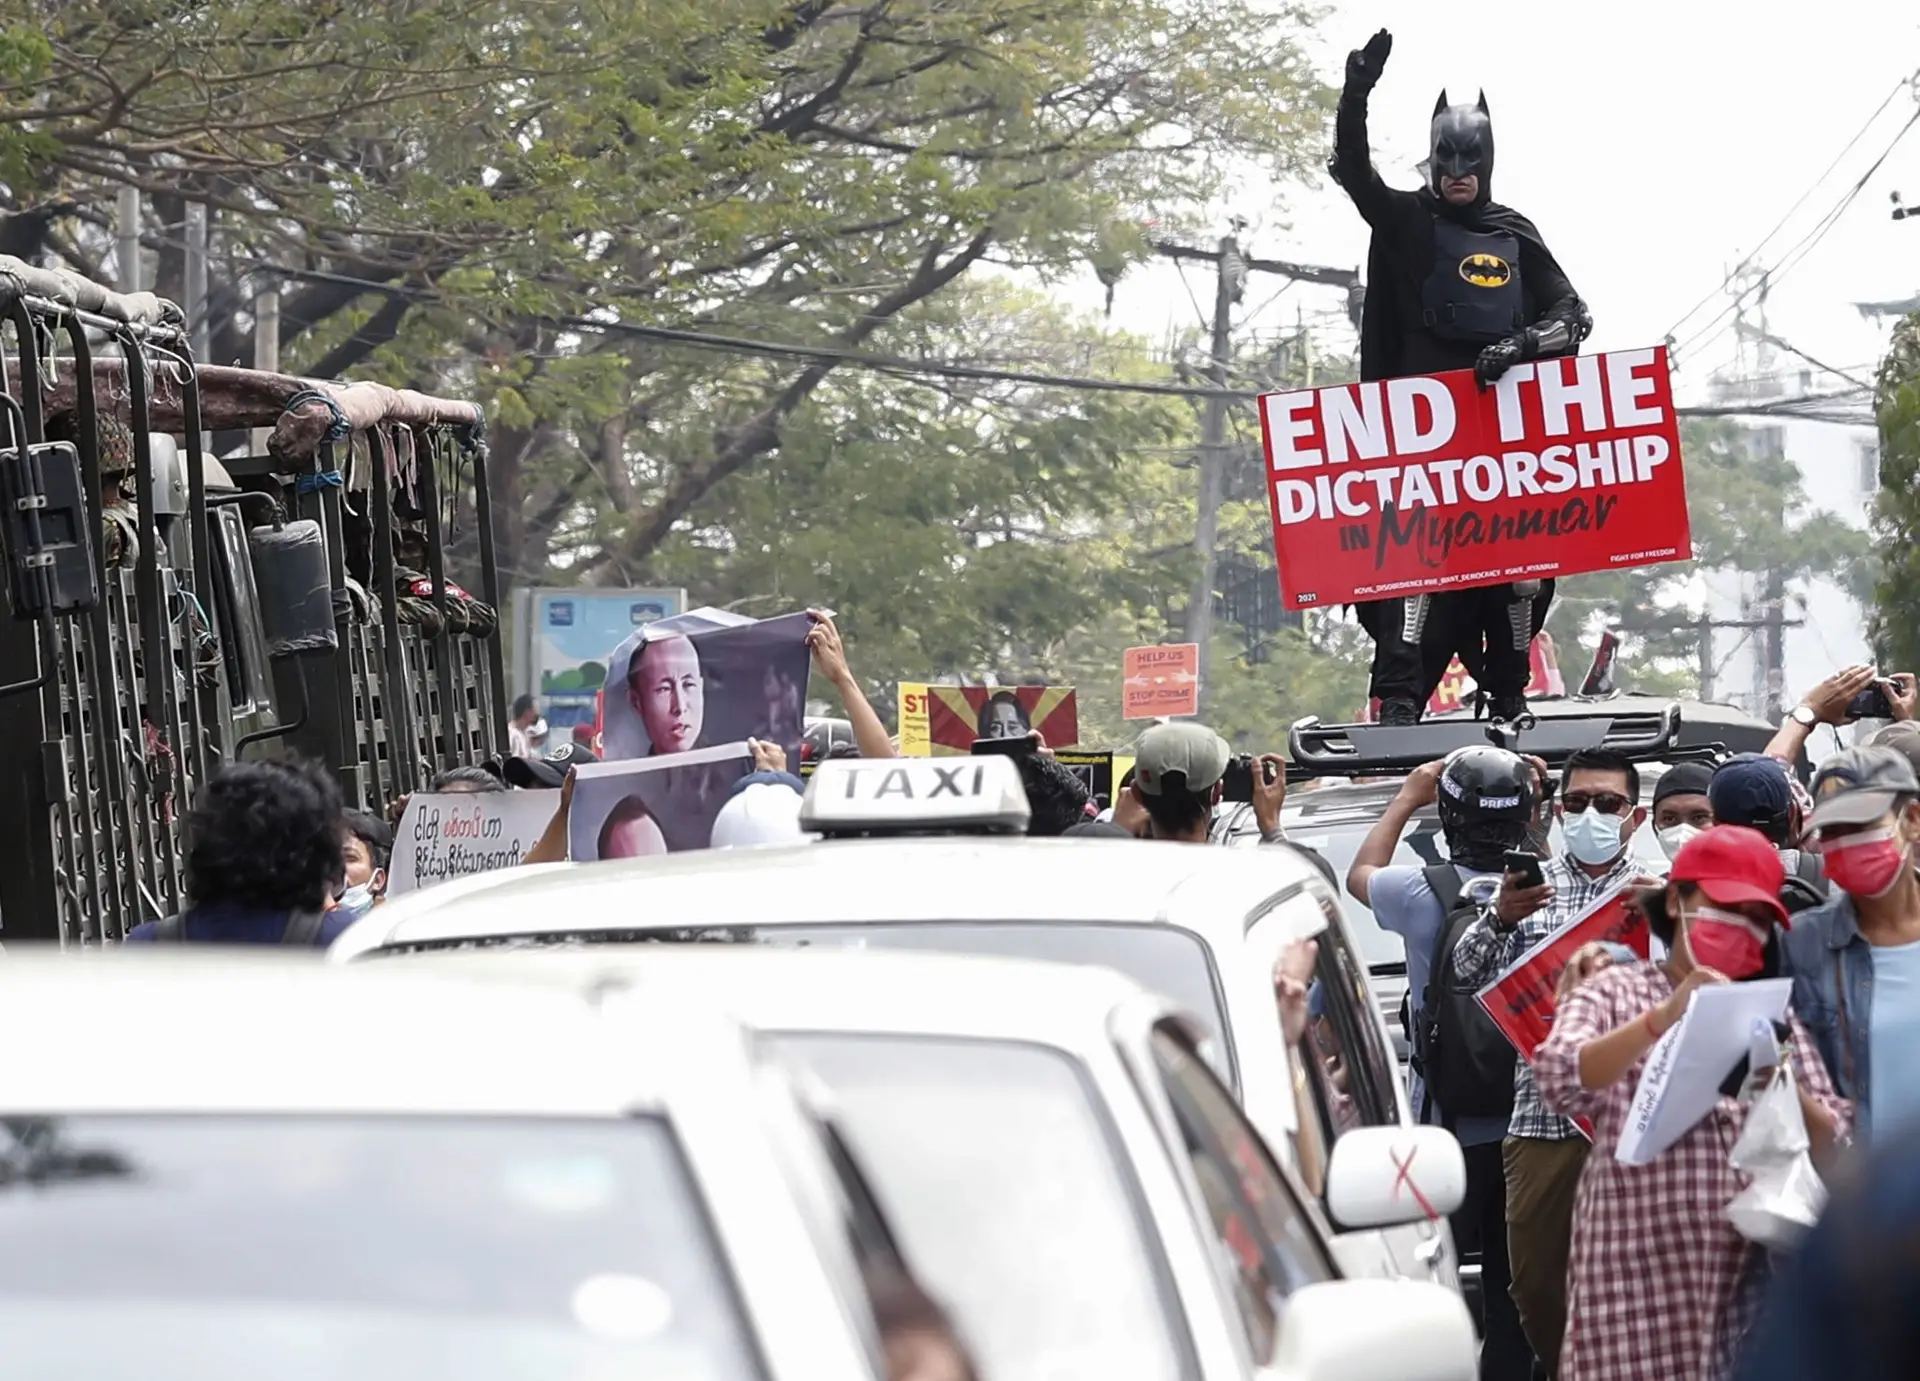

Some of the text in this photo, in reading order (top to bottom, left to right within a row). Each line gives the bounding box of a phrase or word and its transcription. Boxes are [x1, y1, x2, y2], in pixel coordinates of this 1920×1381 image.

[1266, 348, 1664, 471] END THE
[1276, 434, 1670, 525] DICTATORSHIP
[1339, 493, 1618, 570] IN Myanmar
[1610, 547, 1676, 563] FIGHT FOR FREEDOM
[1297, 593, 1317, 603] 2021
[1137, 651, 1184, 663] HELP US
[1129, 690, 1155, 701] STOP
[837, 764, 984, 800] TAXI
[1479, 797, 1520, 809] PRESS
